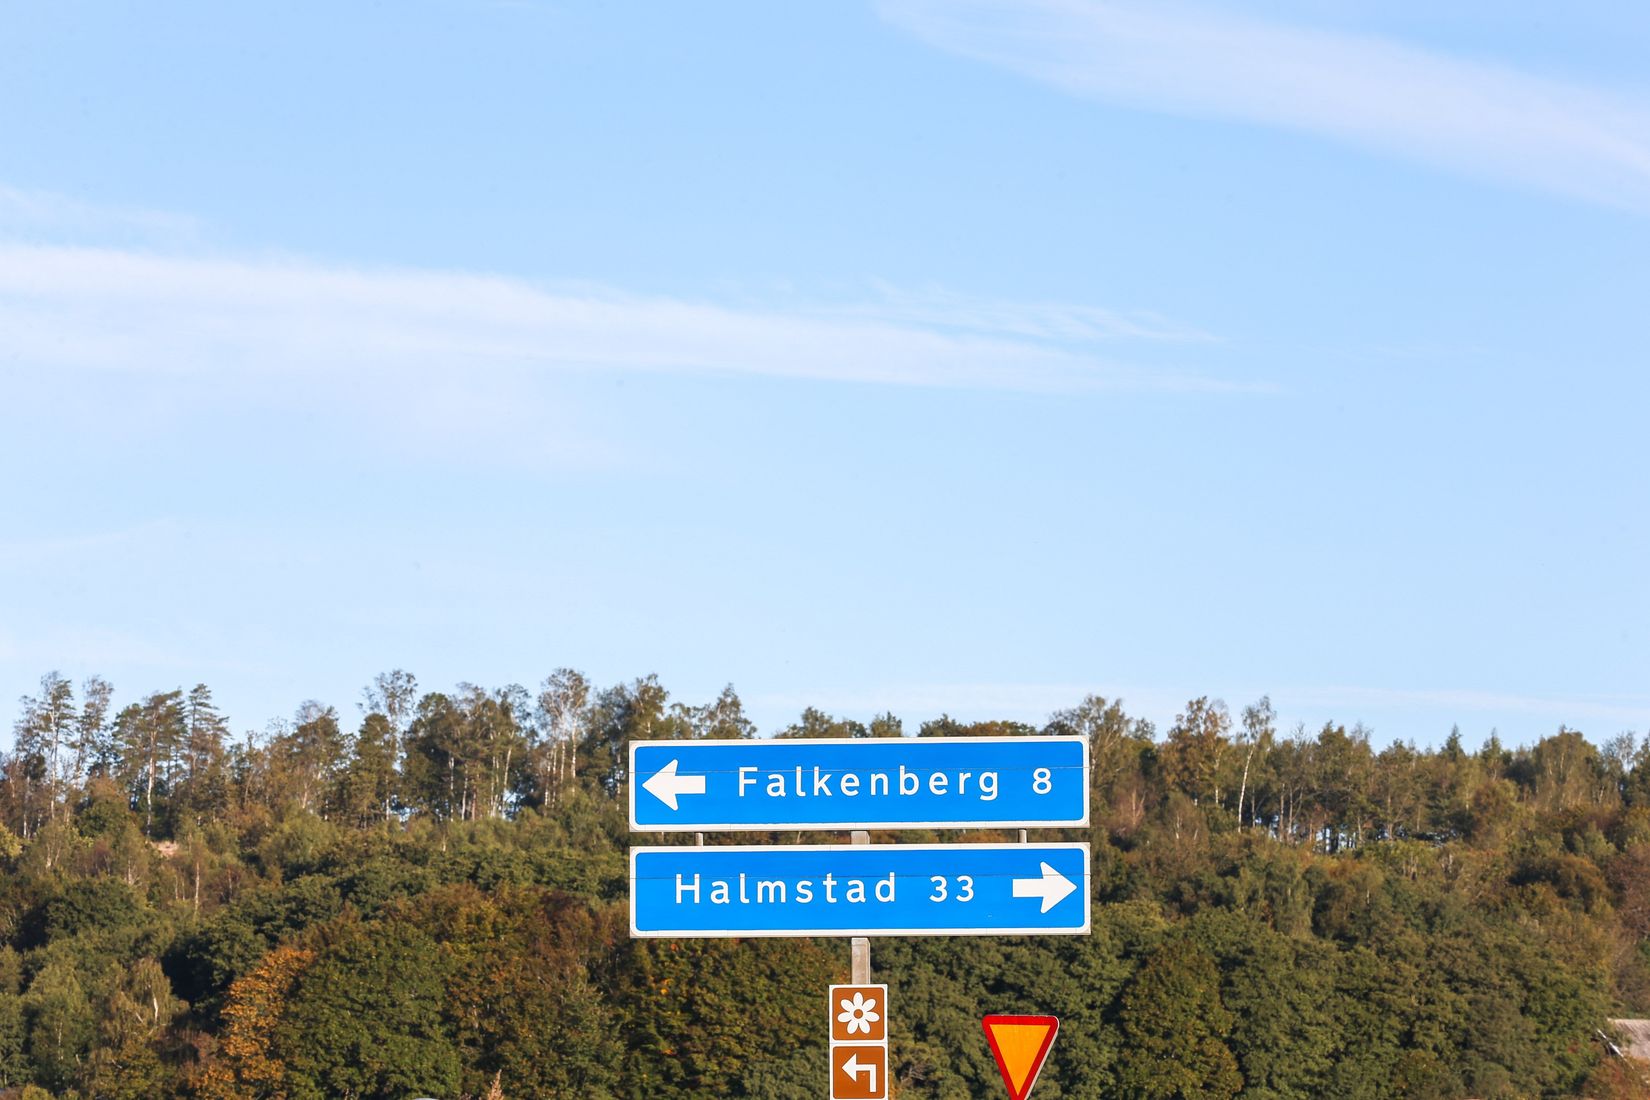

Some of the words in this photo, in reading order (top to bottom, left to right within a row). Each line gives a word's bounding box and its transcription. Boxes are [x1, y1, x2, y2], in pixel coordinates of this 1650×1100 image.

[738, 765, 998, 801] Falkenberg
[1032, 767, 1052, 795] 8
[675, 872, 895, 904] Halmstad
[929, 875, 974, 903] 33
